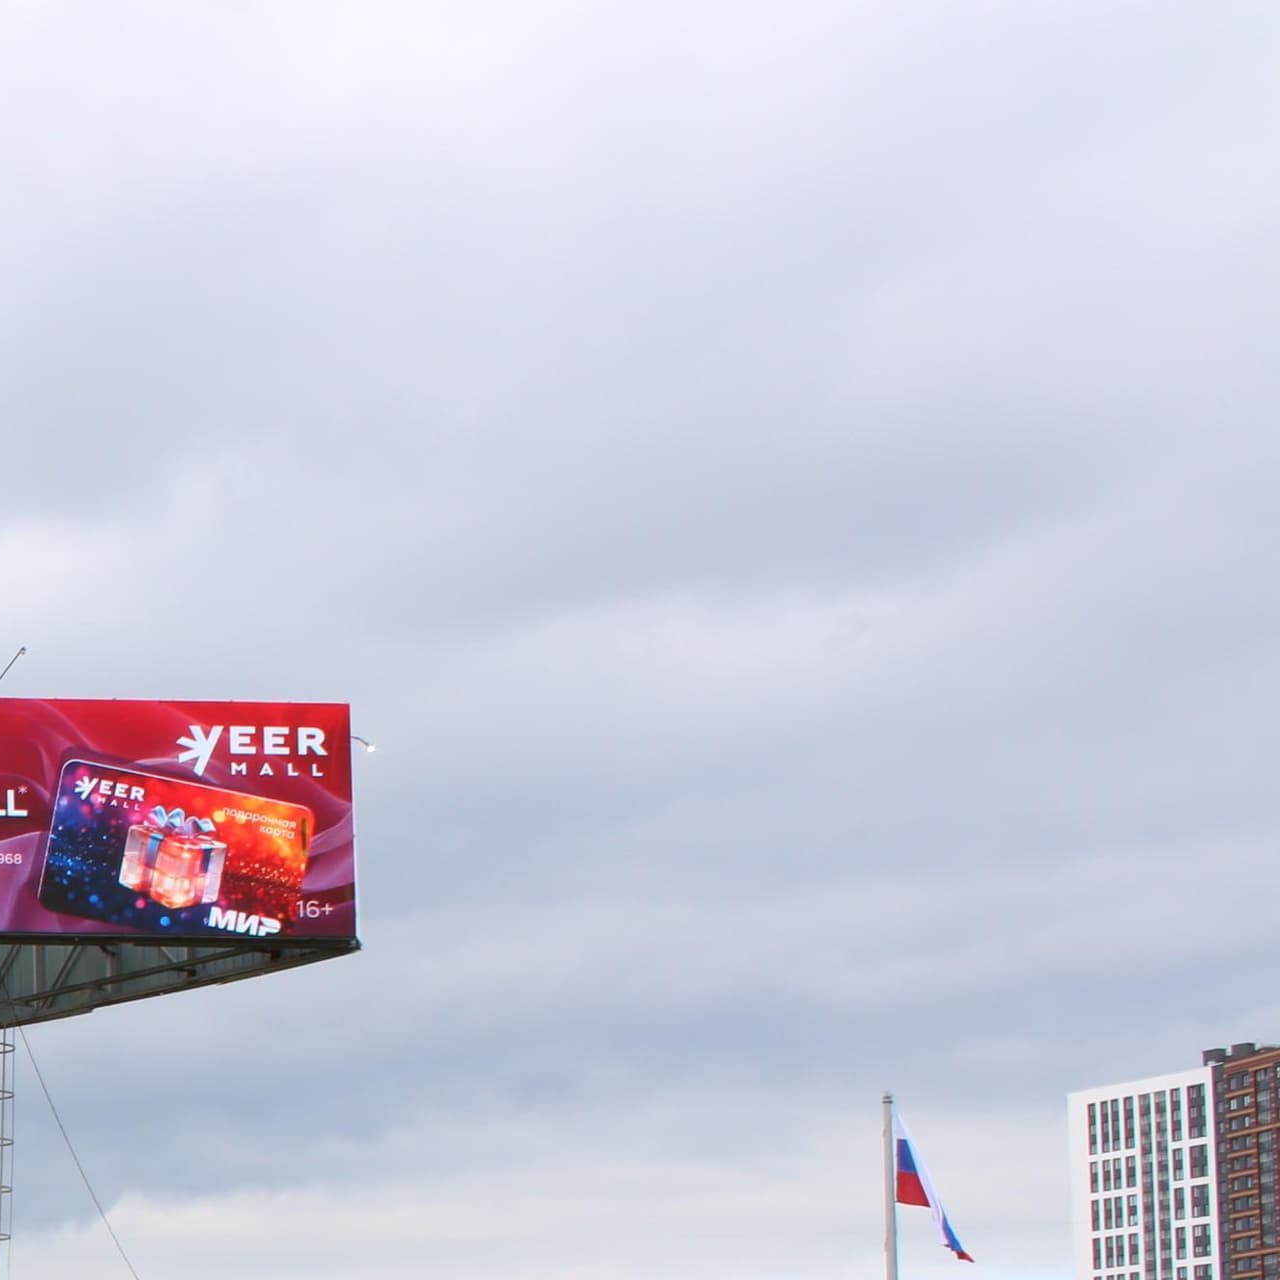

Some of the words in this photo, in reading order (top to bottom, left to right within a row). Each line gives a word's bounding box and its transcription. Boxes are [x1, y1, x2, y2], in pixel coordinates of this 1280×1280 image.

[231, 762, 324, 777] MALL
[98, 797, 141, 811] MALL
[222, 806, 297, 829] подарочная
[259, 825, 296, 840] карта
[296, 899, 334, 919] 16+
[208, 906, 282, 937] МИР
